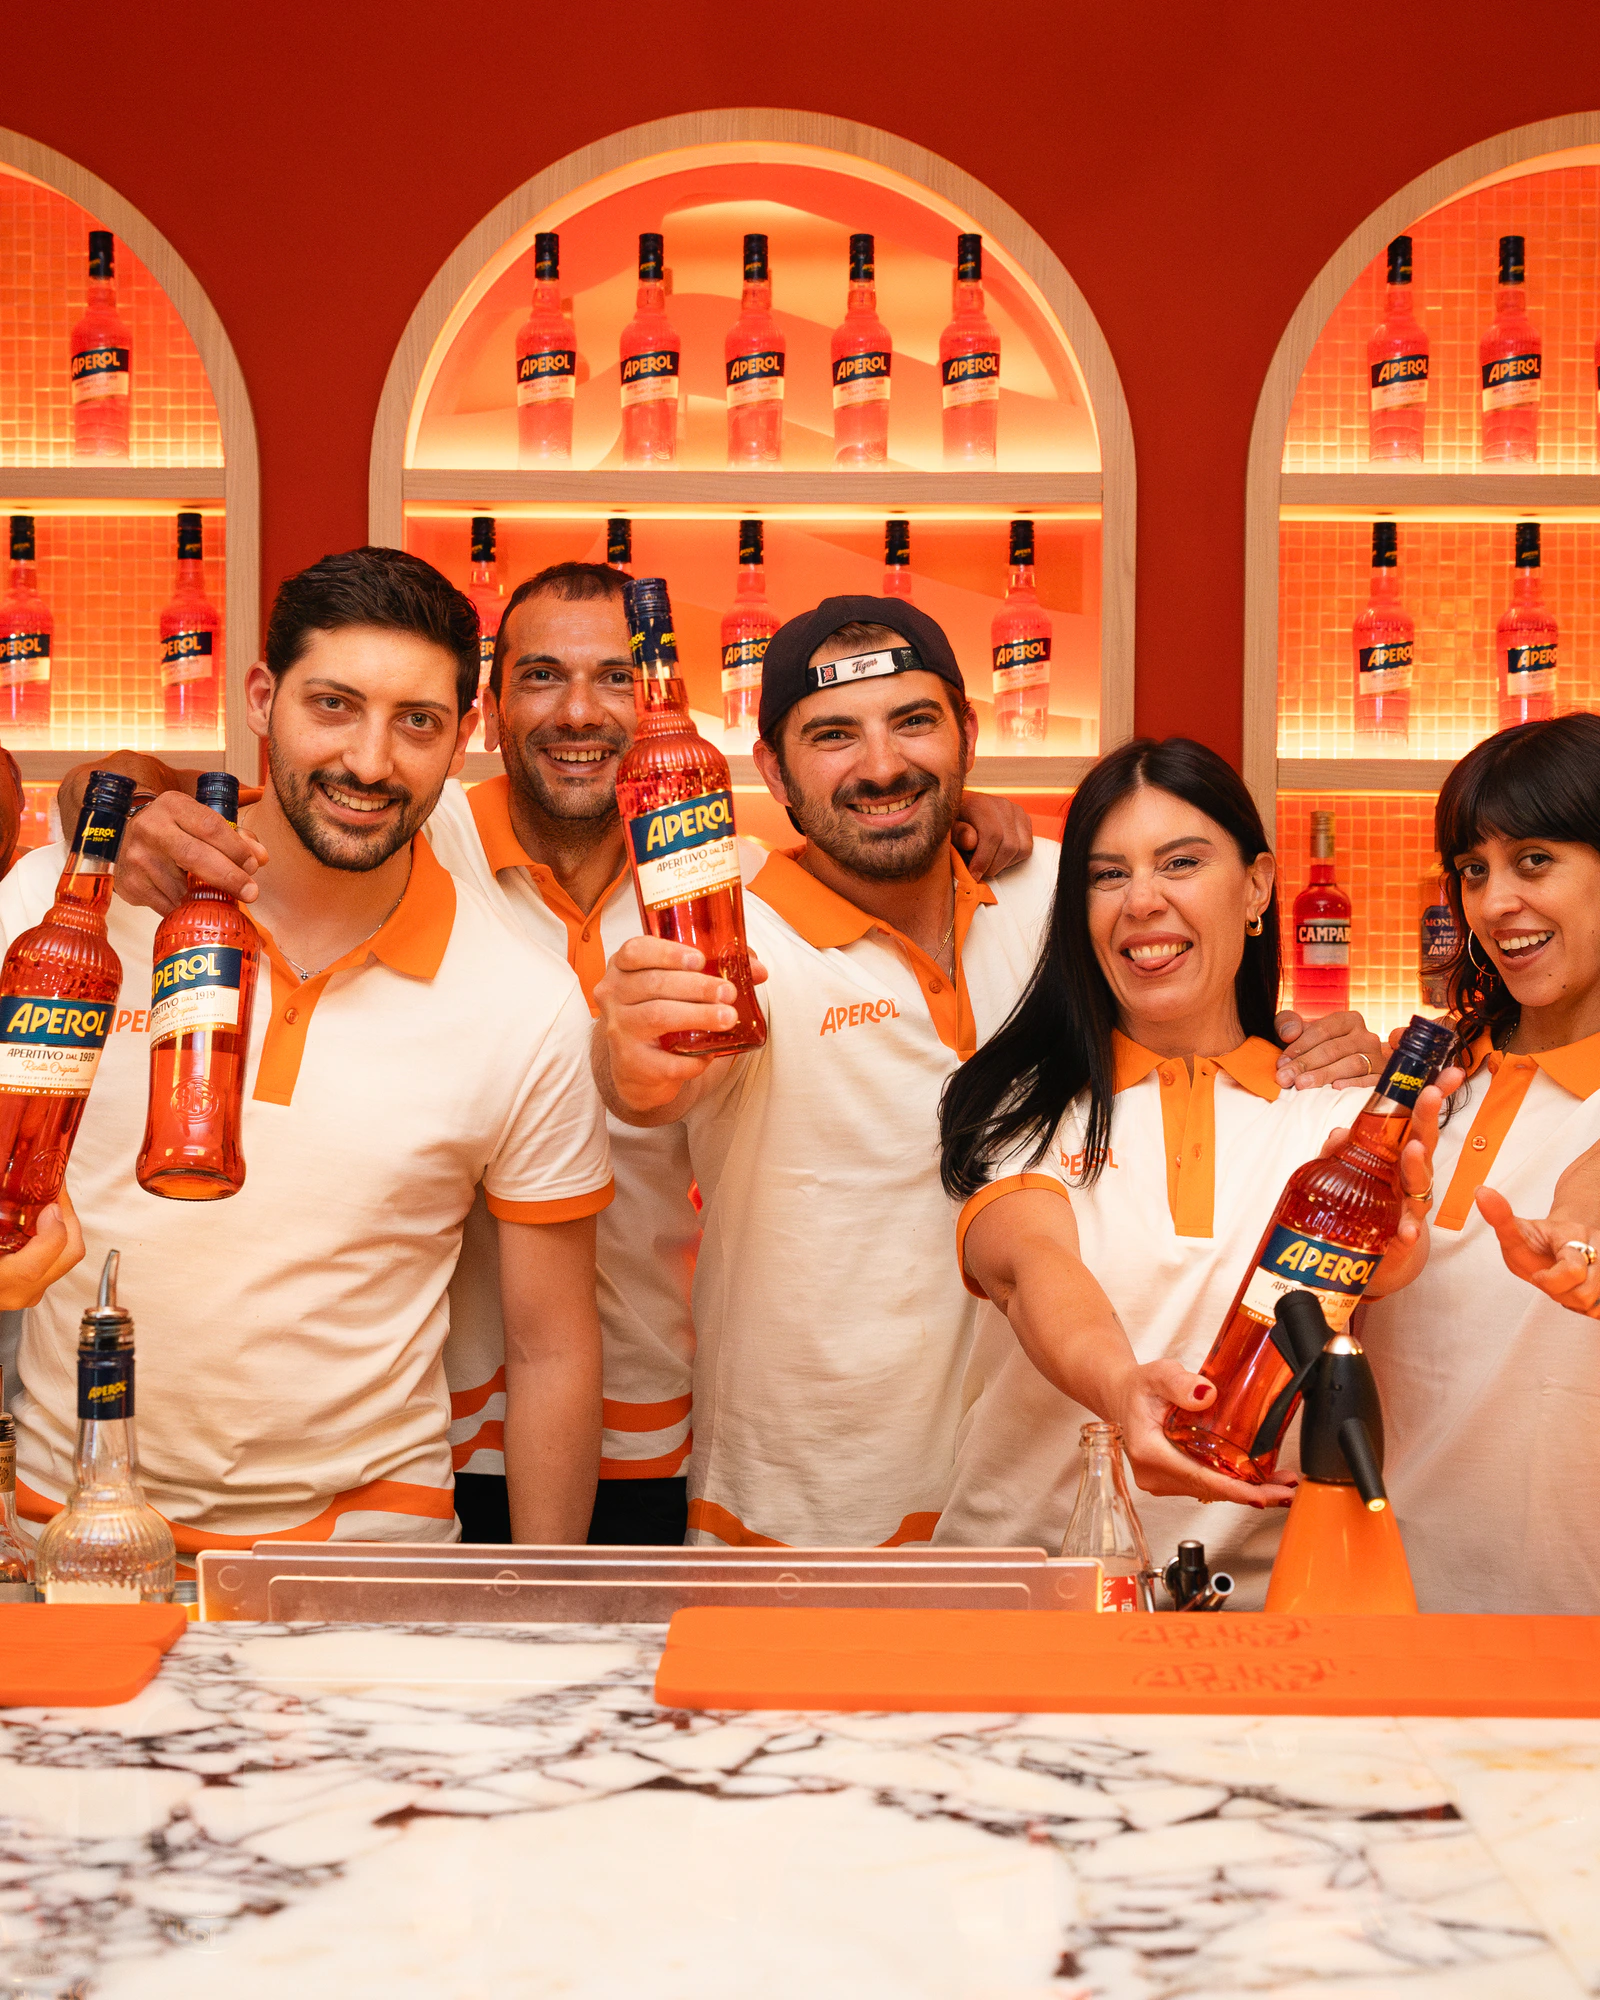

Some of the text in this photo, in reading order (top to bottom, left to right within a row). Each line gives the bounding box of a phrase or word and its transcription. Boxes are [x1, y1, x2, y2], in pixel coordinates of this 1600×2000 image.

[72, 351, 120, 377] APEROL
[520, 354, 571, 379] APEROL
[623, 355, 673, 380] APEROL
[730, 355, 780, 381] APEROL
[836, 355, 887, 381] APEROL
[947, 356, 998, 380] APEROL
[1378, 358, 1428, 383] APEROL
[1488, 358, 1540, 383] APEROL
[0, 637, 42, 658] PEROL
[161, 635, 202, 659] PEROL
[724, 640, 770, 665] APERO
[996, 641, 1046, 666] APEROL
[1367, 645, 1414, 667] APERO
[852, 658, 878, 674] Tigers
[81, 826, 116, 838] APEROL
[646, 798, 733, 852] APEROL
[656, 849, 708, 873] APERITIVO
[653, 902, 669, 910] CASA
[669, 891, 701, 905] FONDATA
[1298, 926, 1351, 943] CAMPAR
[151, 952, 221, 1000] PEROL
[195, 990, 216, 1001] 1919
[6, 1002, 107, 1038] APEROL
[820, 997, 901, 1037] APEROL
[7, 1048, 96, 1063] APERITIVO DAL 1919
[7, 1086, 40, 1095] FONDATA
[1060, 1147, 1119, 1176] PEL
[1275, 1239, 1376, 1287] APEROL
[1246, 1310, 1263, 1321] CASA
